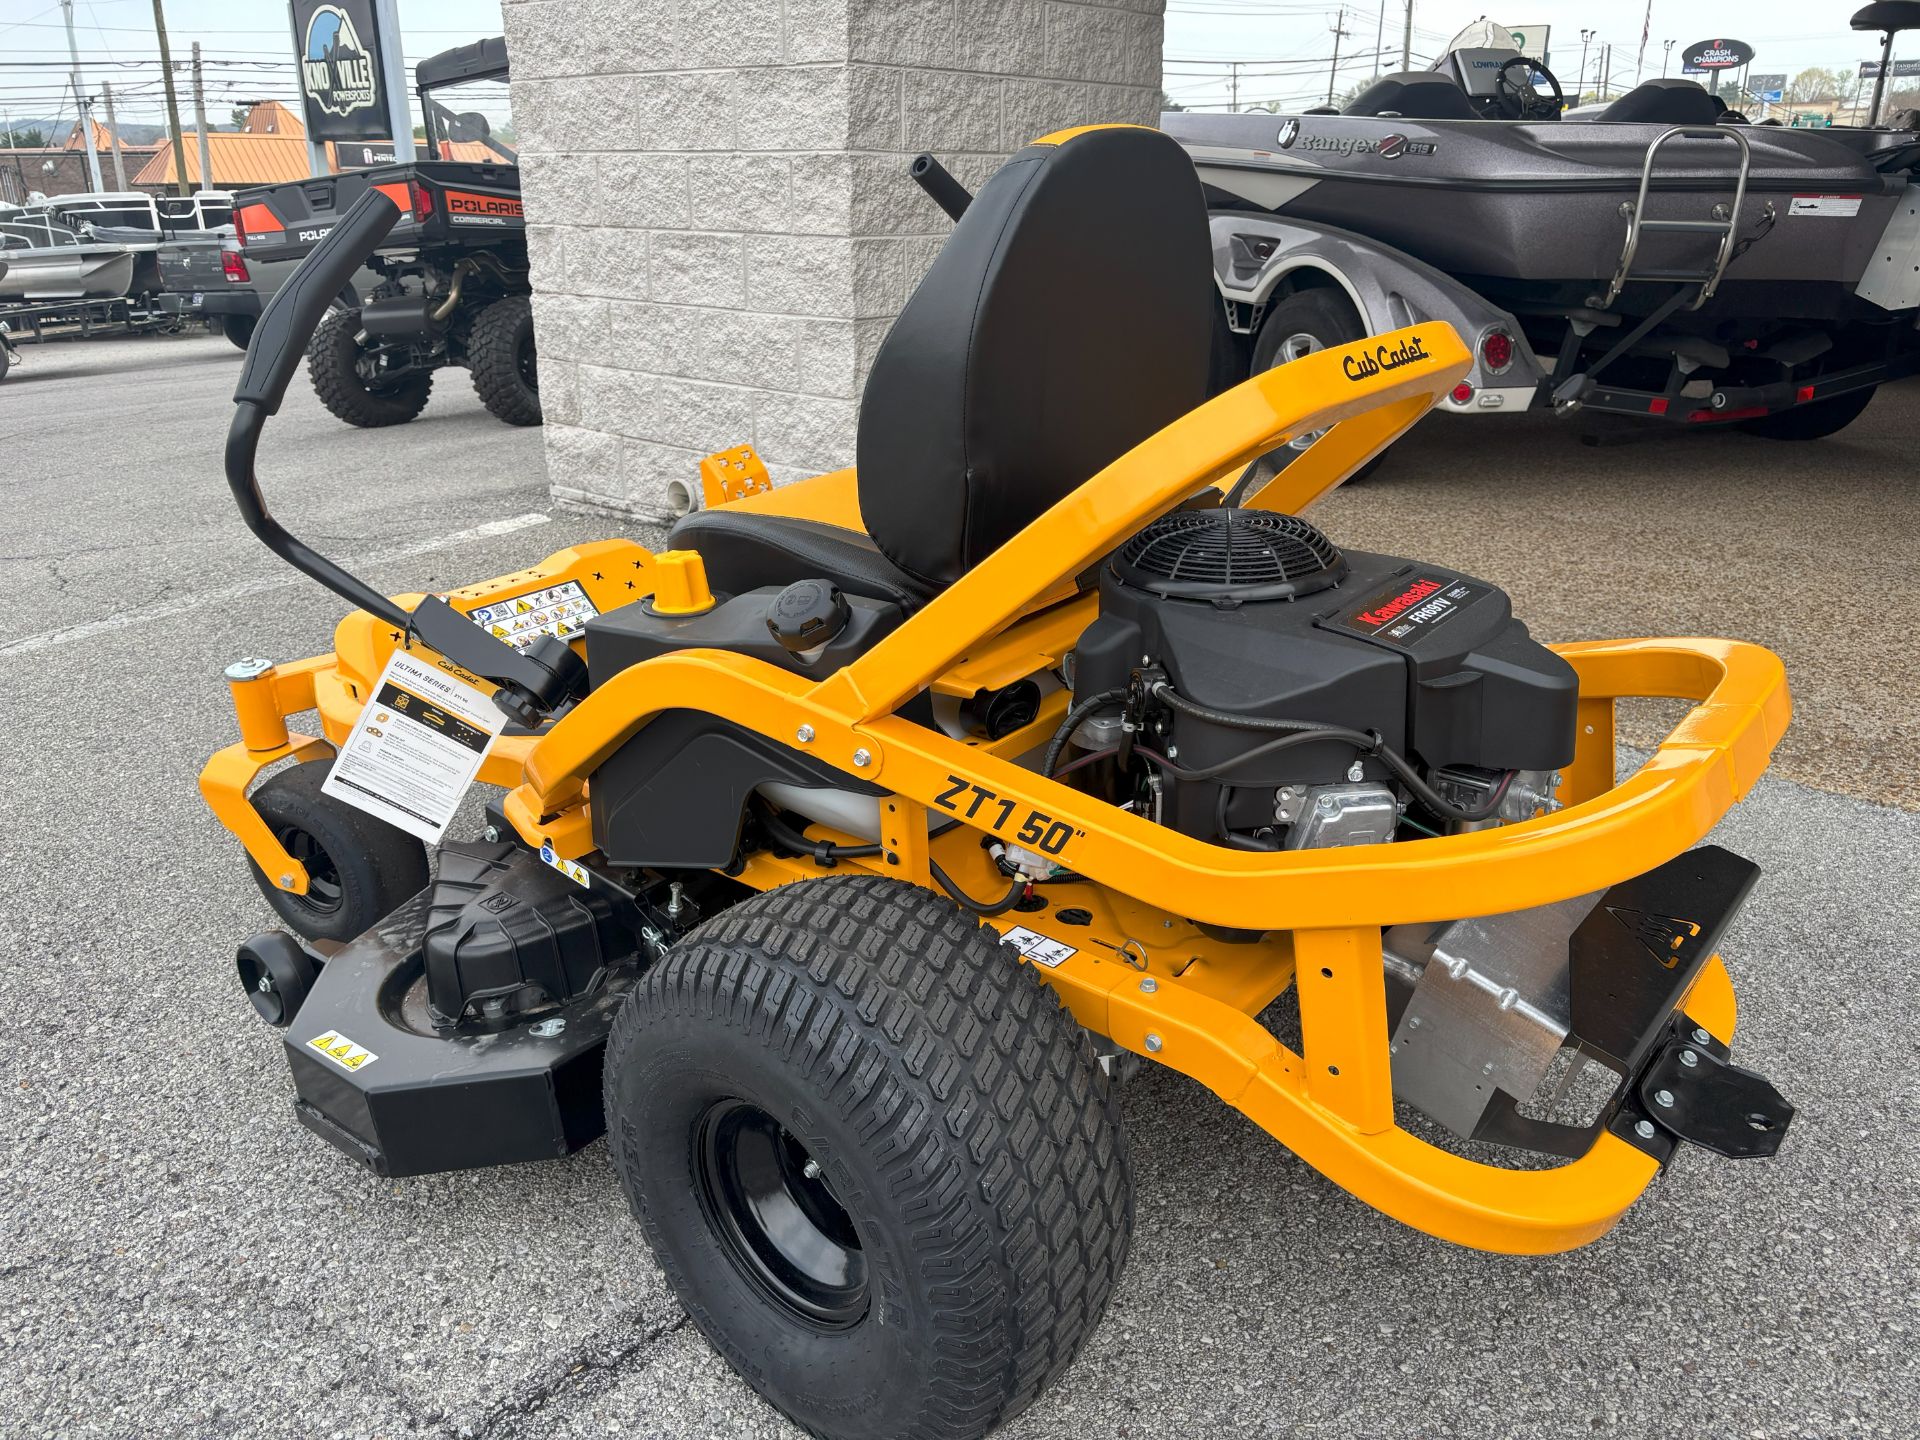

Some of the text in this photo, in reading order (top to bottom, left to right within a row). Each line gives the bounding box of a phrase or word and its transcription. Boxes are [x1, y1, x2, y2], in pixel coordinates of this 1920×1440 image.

[1693, 55, 1740, 63] CHAMPIONS
[304, 58, 371, 90] KNOXVILLE
[333, 90, 371, 102] POWERSPORTS
[1295, 134, 1381, 157] Ranger
[451, 199, 524, 215] POLARIS
[453, 216, 506, 225] COMMERCIAL
[1343, 336, 1430, 382] Cub Cadet
[1356, 578, 1442, 626] Kawasaki
[1408, 597, 1452, 624] FR691V
[394, 661, 423, 679] ULTIMA
[422, 675, 452, 693] SERIES
[437, 660, 480, 686] Cub Cadet
[934, 774, 1086, 855] ZT1 50"
